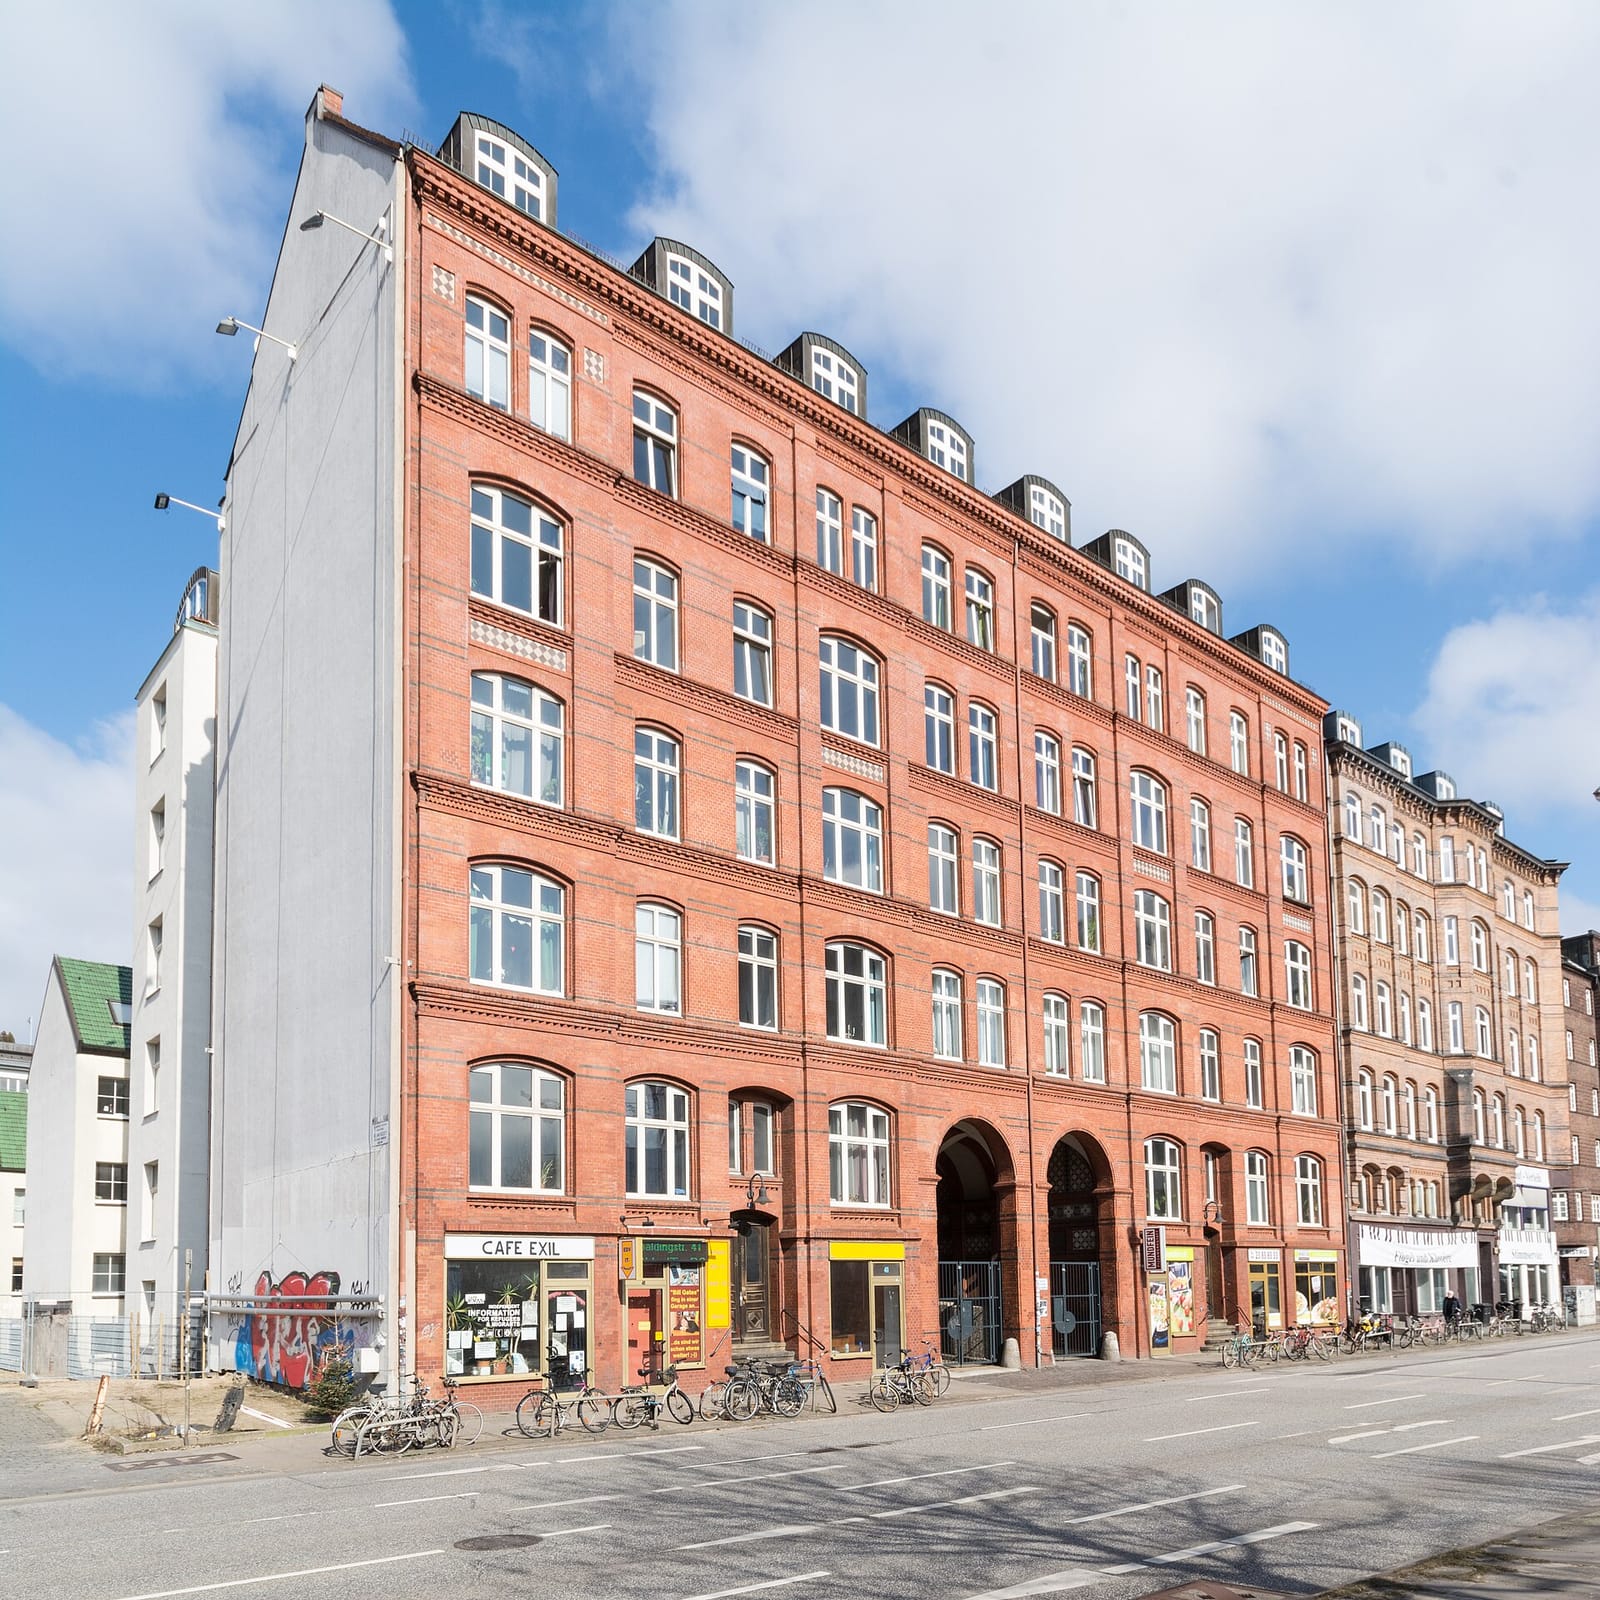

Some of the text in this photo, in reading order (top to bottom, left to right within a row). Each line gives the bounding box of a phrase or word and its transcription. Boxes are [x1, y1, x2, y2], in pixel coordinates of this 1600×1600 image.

[482, 1241, 560, 1256] CAFE EXIL
[643, 1243, 687, 1253] aldingstr.
[690, 1243, 702, 1252] 41
[1147, 1231, 1156, 1267] MUNDFEIN
[468, 1309, 520, 1317] INFORMATION
